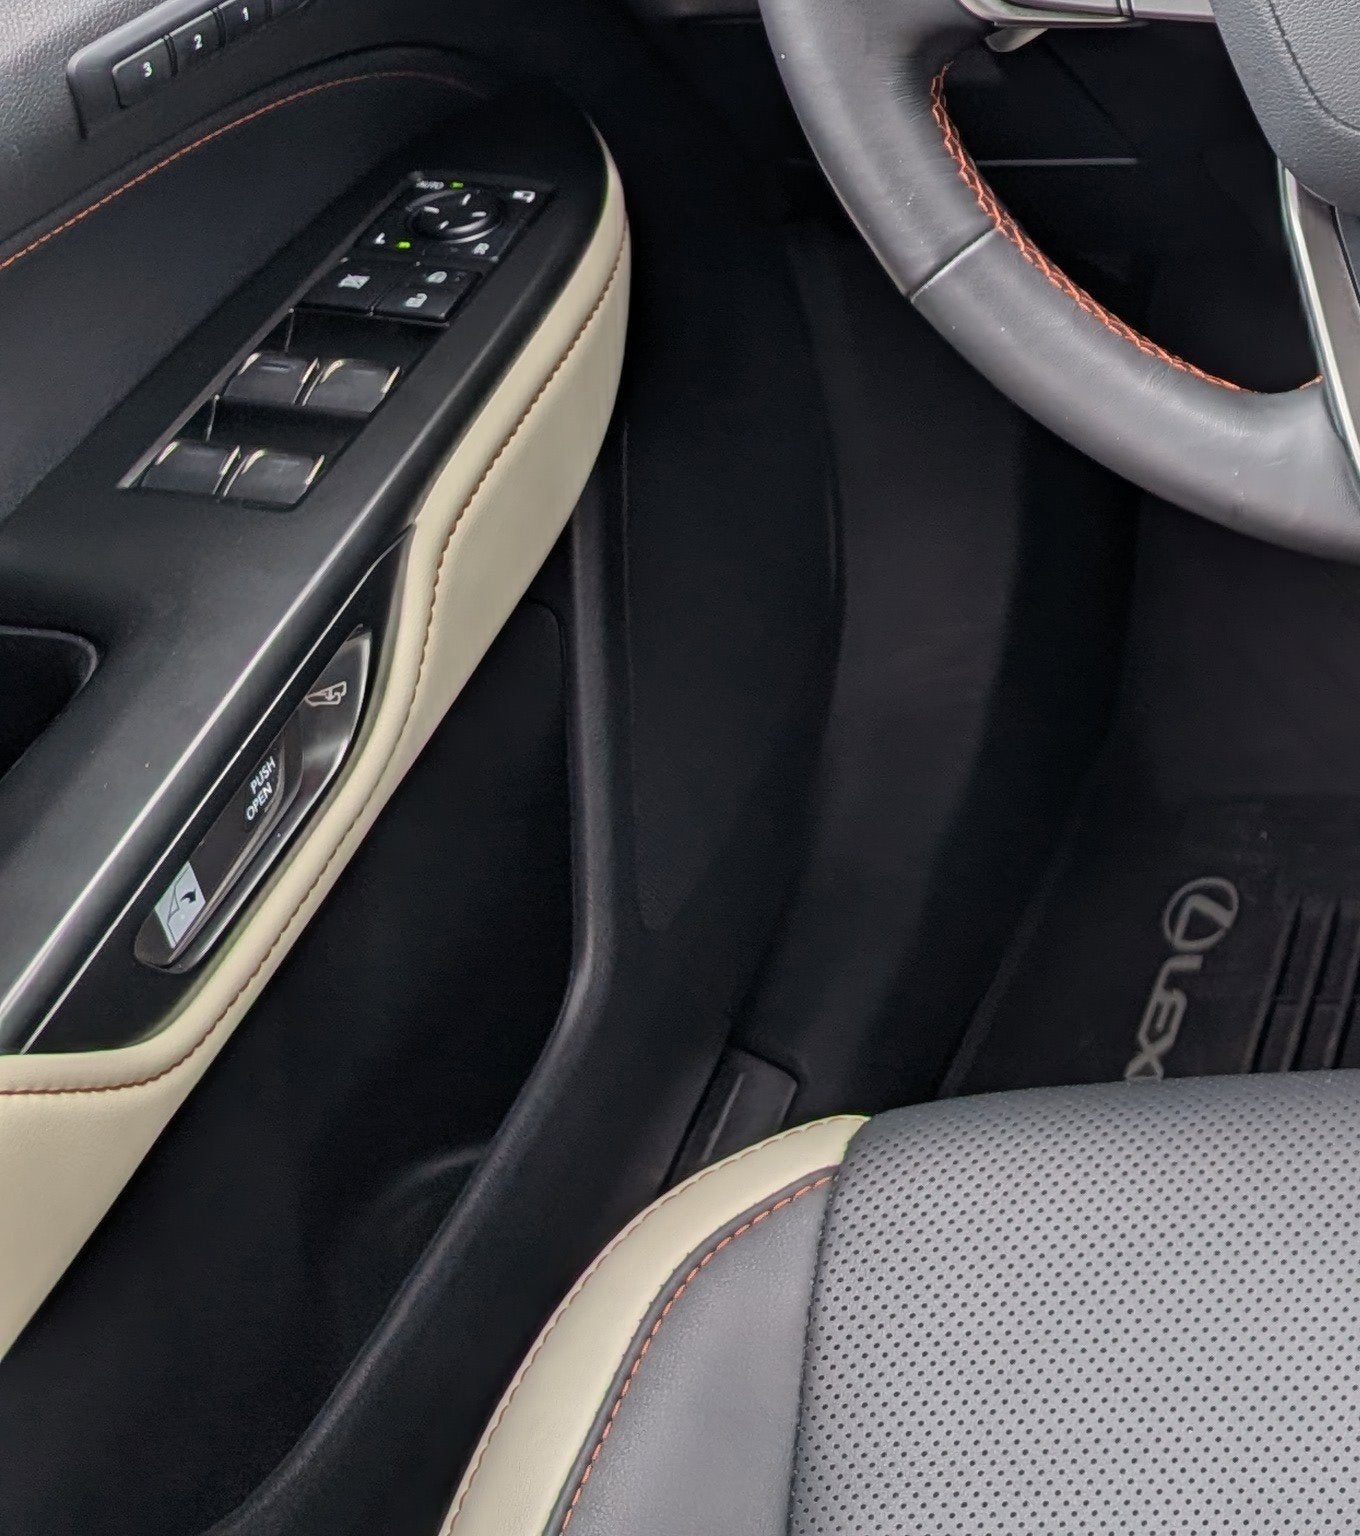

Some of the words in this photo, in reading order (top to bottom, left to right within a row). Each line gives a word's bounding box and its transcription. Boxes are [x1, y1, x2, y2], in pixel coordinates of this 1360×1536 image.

[242, 7, 250, 21] 1
[194, 34, 203, 50] 2
[143, 61, 152, 78] 3
[249, 756, 276, 796] PUSH
[245, 782, 273, 822] OPEN
